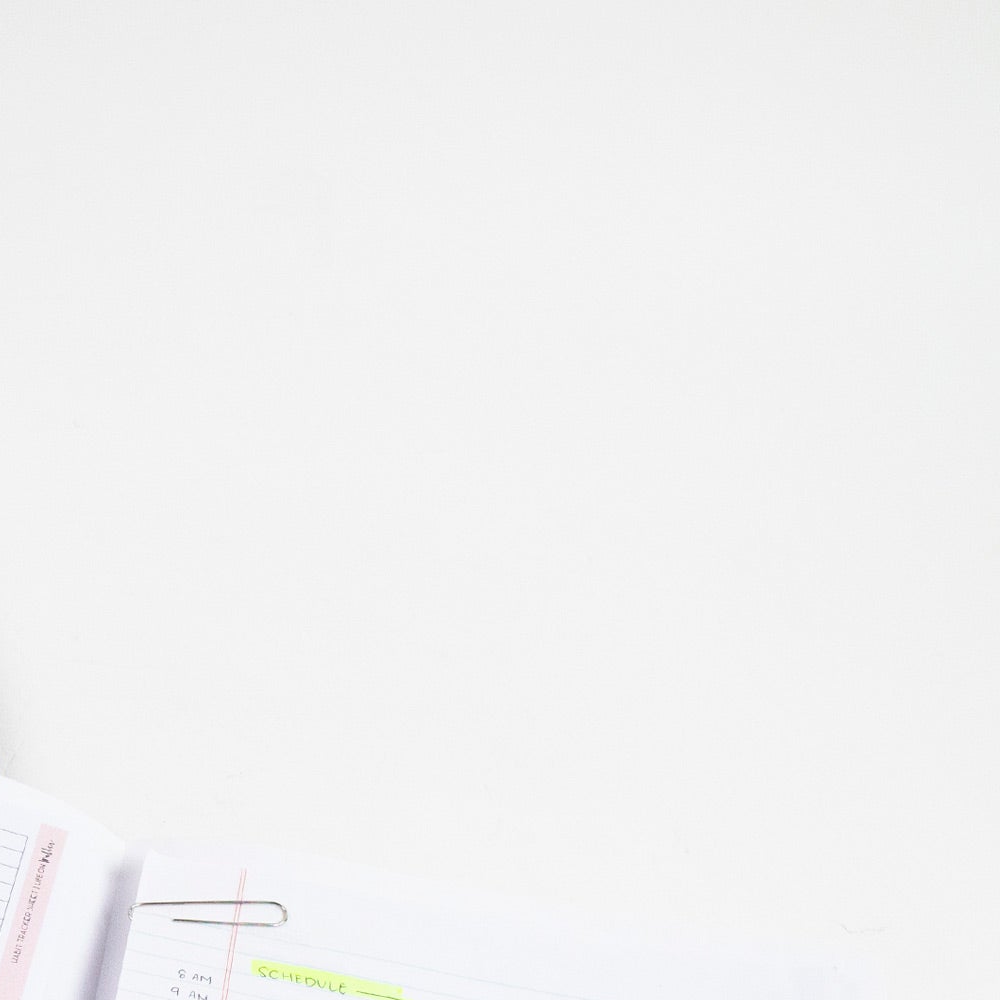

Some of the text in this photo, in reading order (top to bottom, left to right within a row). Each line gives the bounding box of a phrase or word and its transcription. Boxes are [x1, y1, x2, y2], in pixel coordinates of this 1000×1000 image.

[17, 912, 31, 941] TRACKER
[192, 973, 212, 984] AM
[258, 966, 349, 995] SCHEDULE
